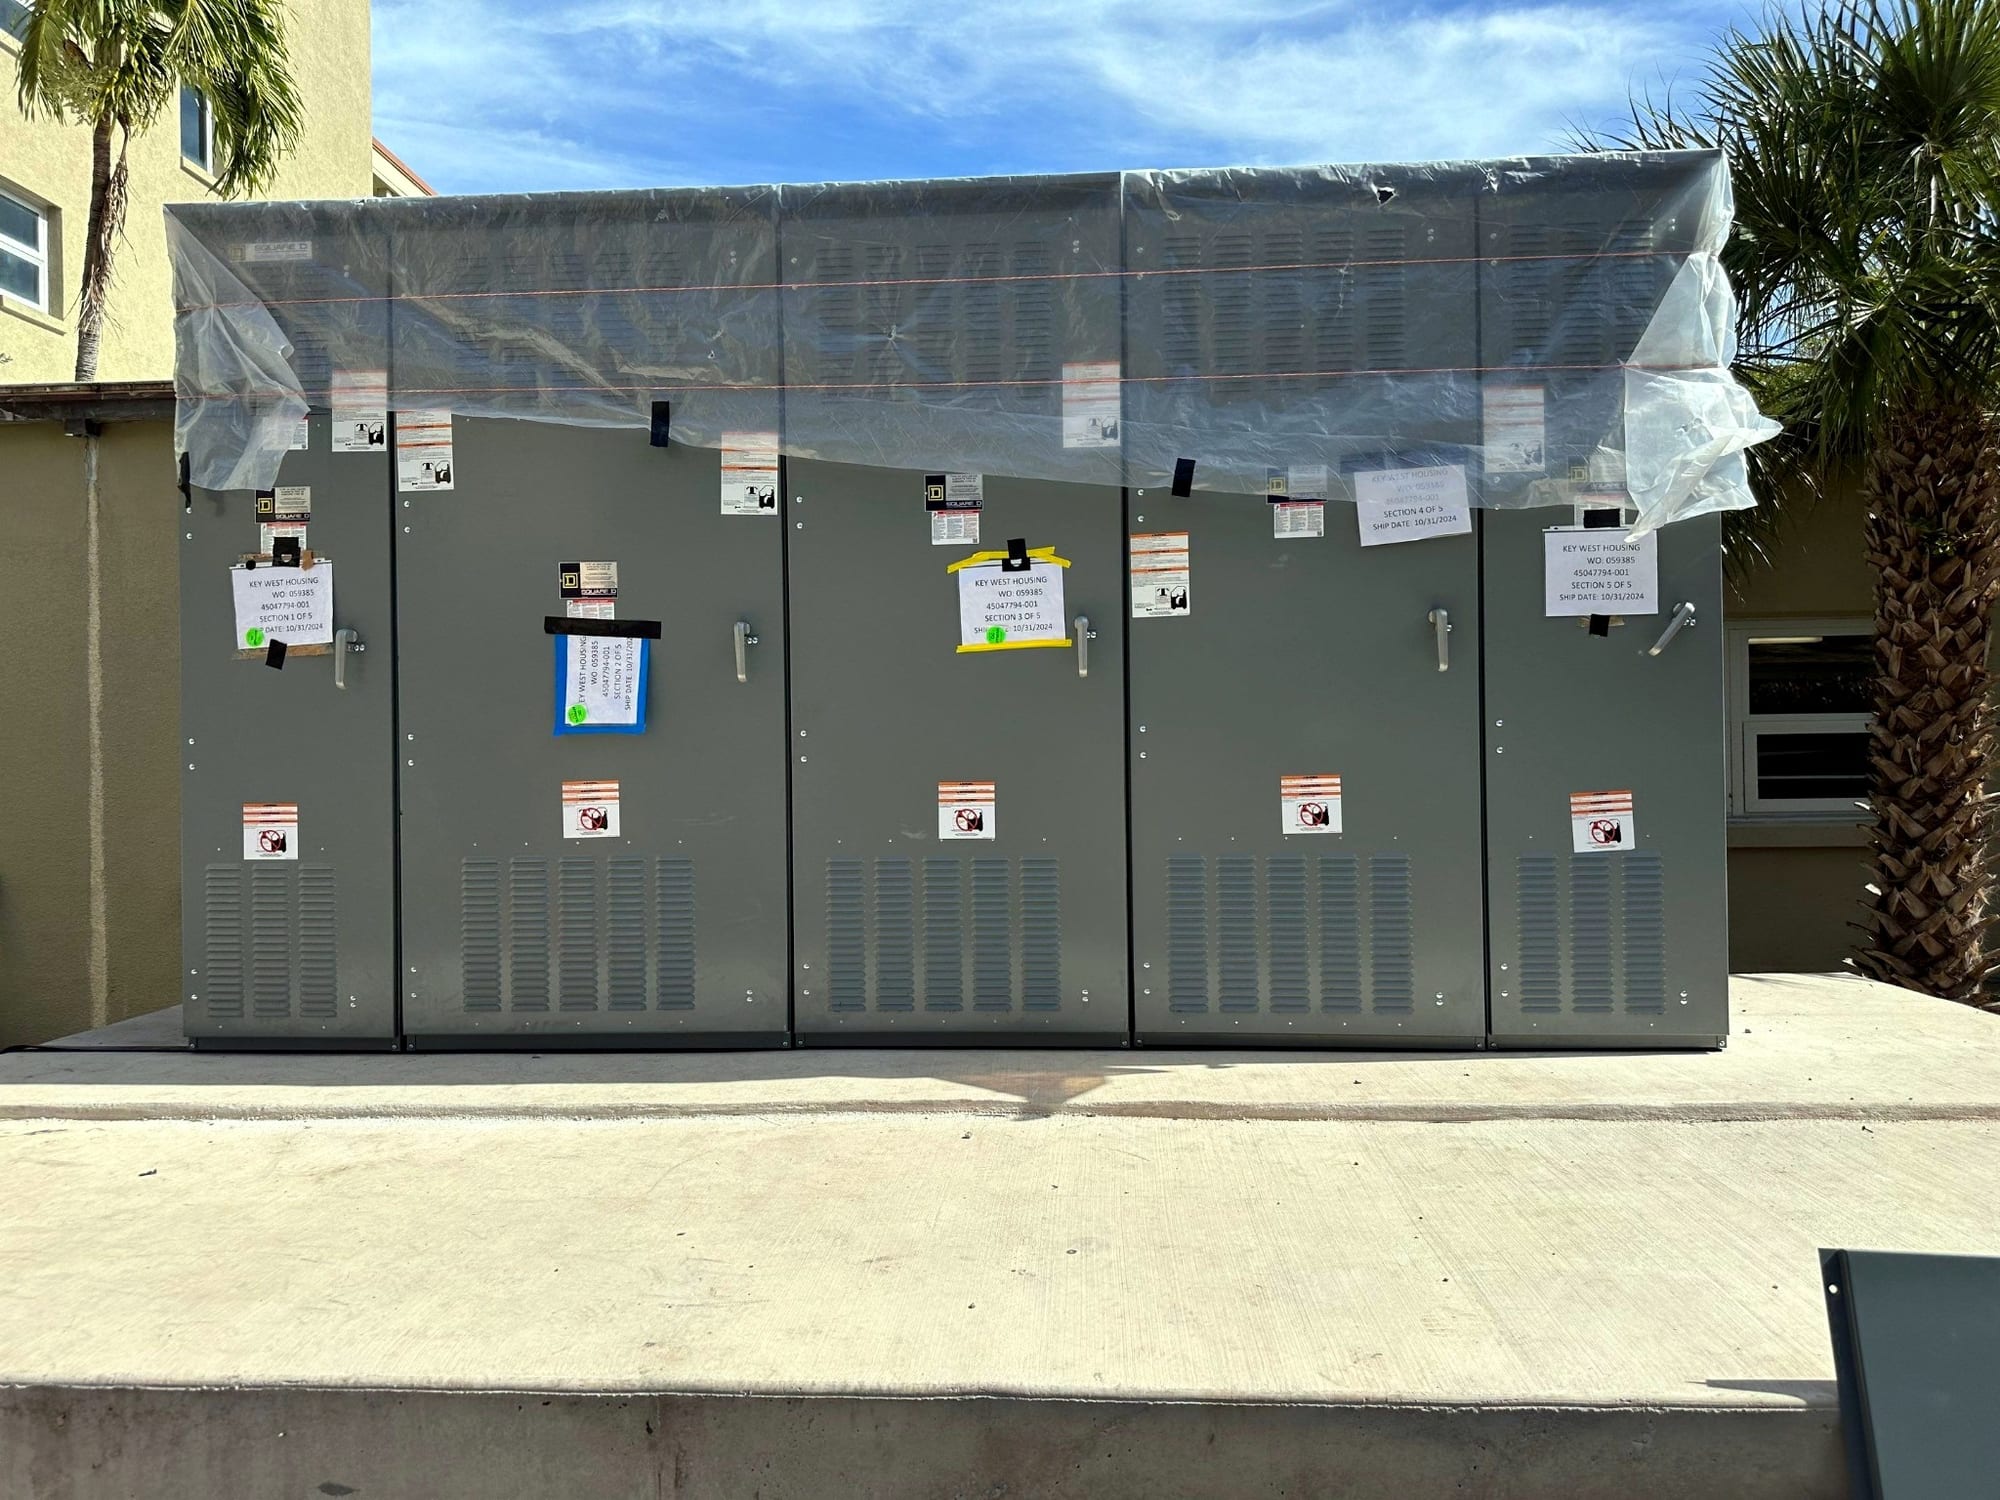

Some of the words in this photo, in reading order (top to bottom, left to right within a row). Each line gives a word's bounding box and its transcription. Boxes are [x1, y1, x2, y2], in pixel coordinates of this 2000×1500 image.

[1411, 469, 1448, 479] HOUSING
[1383, 507, 1417, 518] SECTION
[1418, 506, 1424, 514] 4
[1425, 505, 1437, 514] OF
[1372, 522, 1390, 531] SHIP
[1414, 514, 1457, 526] 10/31/2024
[1562, 545, 1577, 553] KEY
[1579, 544, 1601, 552] WEST
[1602, 543, 1641, 552] HOUSING
[1587, 557, 1604, 565] WO:
[1605, 556, 1635, 565] 059385
[1573, 569, 1629, 577] 45047794-001
[249, 580, 262, 588] KEY
[264, 579, 284, 587] WEST
[285, 576, 319, 586] HOUSING
[975, 578, 989, 587] KEY
[990, 577, 1011, 586] WEST
[1012, 576, 1048, 585] HOUSING
[1571, 582, 1605, 590] SECTION
[1607, 581, 1612, 589] 5
[1614, 581, 1625, 589] OF
[272, 590, 286, 599] WO:
[289, 589, 315, 598] 059385
[998, 589, 1014, 598] WO:
[1015, 588, 1043, 597] 059385
[1559, 593, 1576, 601] SHIP
[1578, 593, 1598, 601] DATE:
[1601, 592, 1644, 601] 10/31/2024
[261, 600, 310, 611] 45047794-001
[986, 600, 1038, 610] 45047794-001
[259, 613, 289, 623] SECTION
[296, 612, 307, 620] OF
[308, 611, 313, 619] 5
[984, 612, 1016, 622] SECTION
[1018, 612, 1023, 620] 3
[1024, 612, 1035, 620] OF
[1036, 611, 1041, 619] 5
[265, 625, 284, 633] DATE:
[286, 622, 323, 633] 10/31/2024
[1013, 623, 1053, 633] 10/31/2024
[615, 650, 621, 660] OF
[602, 646, 610, 697] 45047794-001
